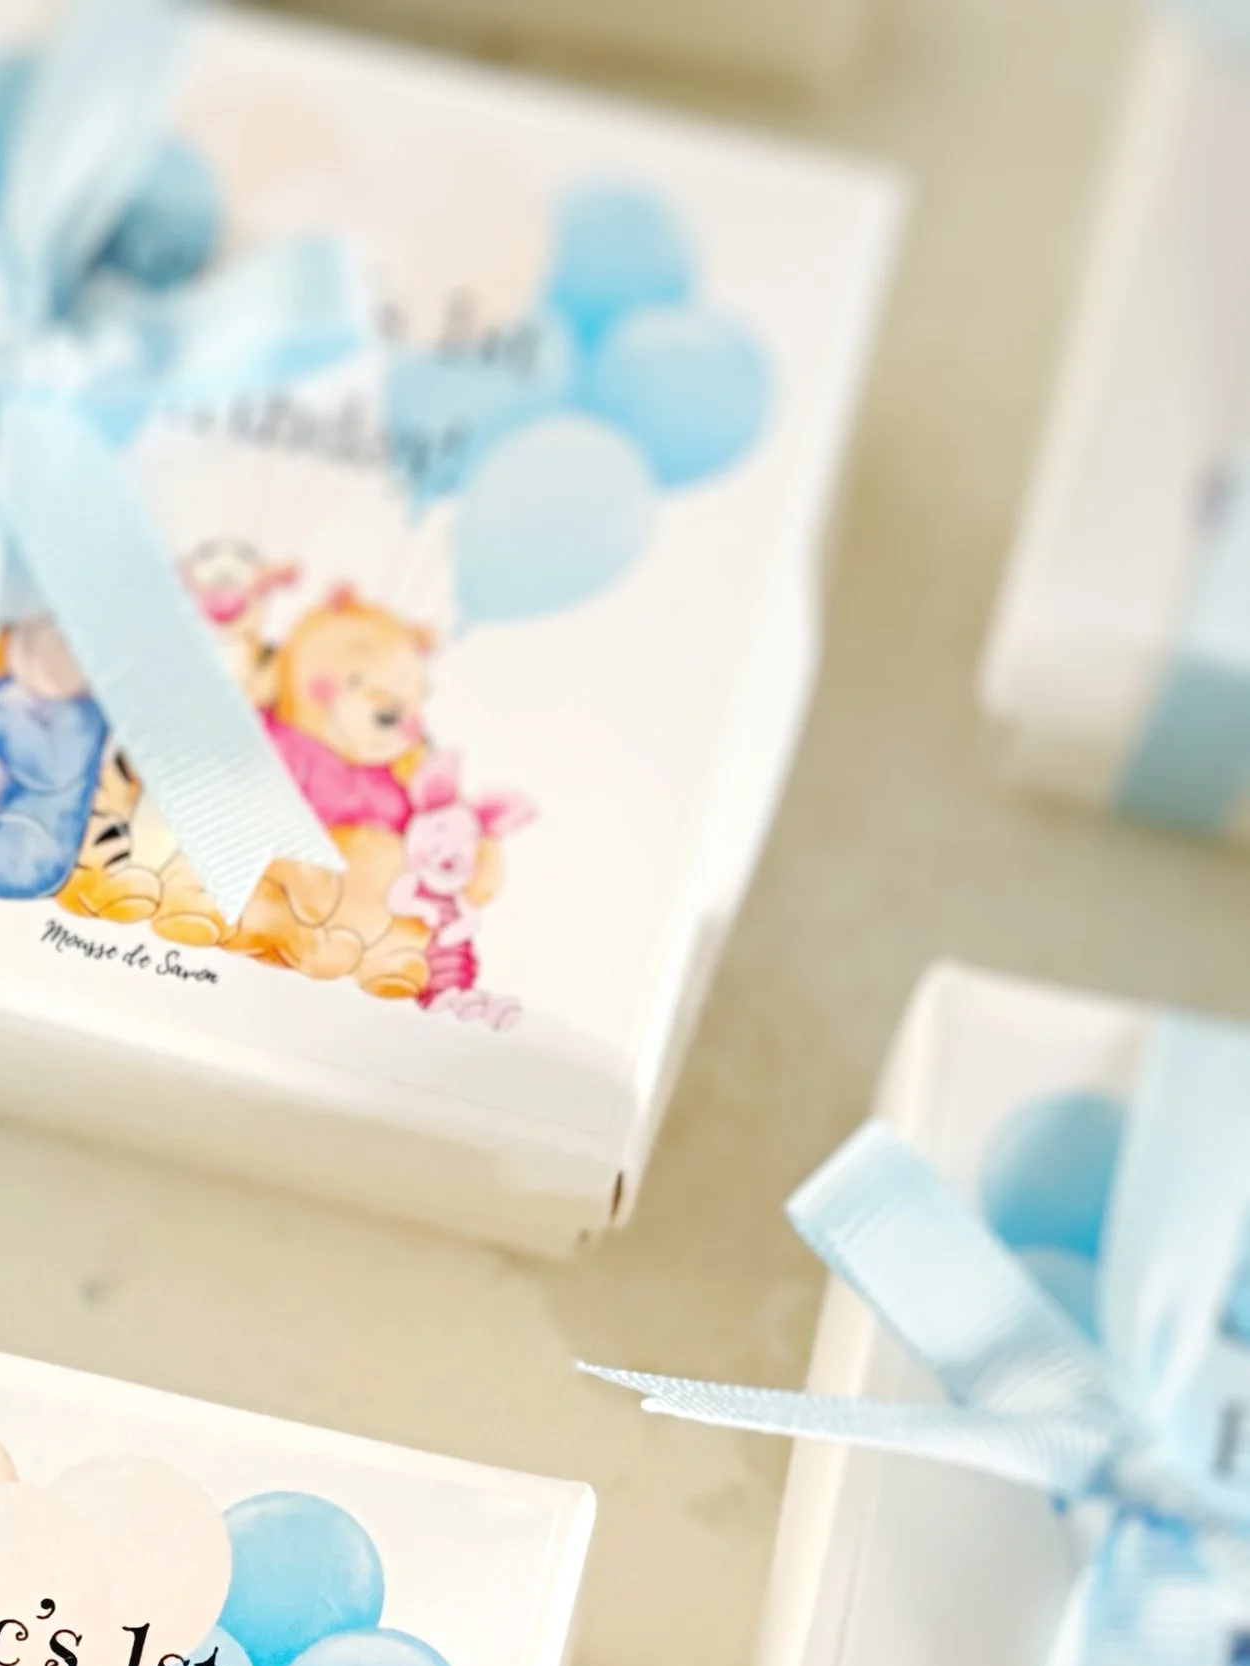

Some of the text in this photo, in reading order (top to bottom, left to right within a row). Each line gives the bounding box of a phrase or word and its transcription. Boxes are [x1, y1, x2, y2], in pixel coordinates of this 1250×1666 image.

[40, 919, 219, 984] Mousse de Savon
